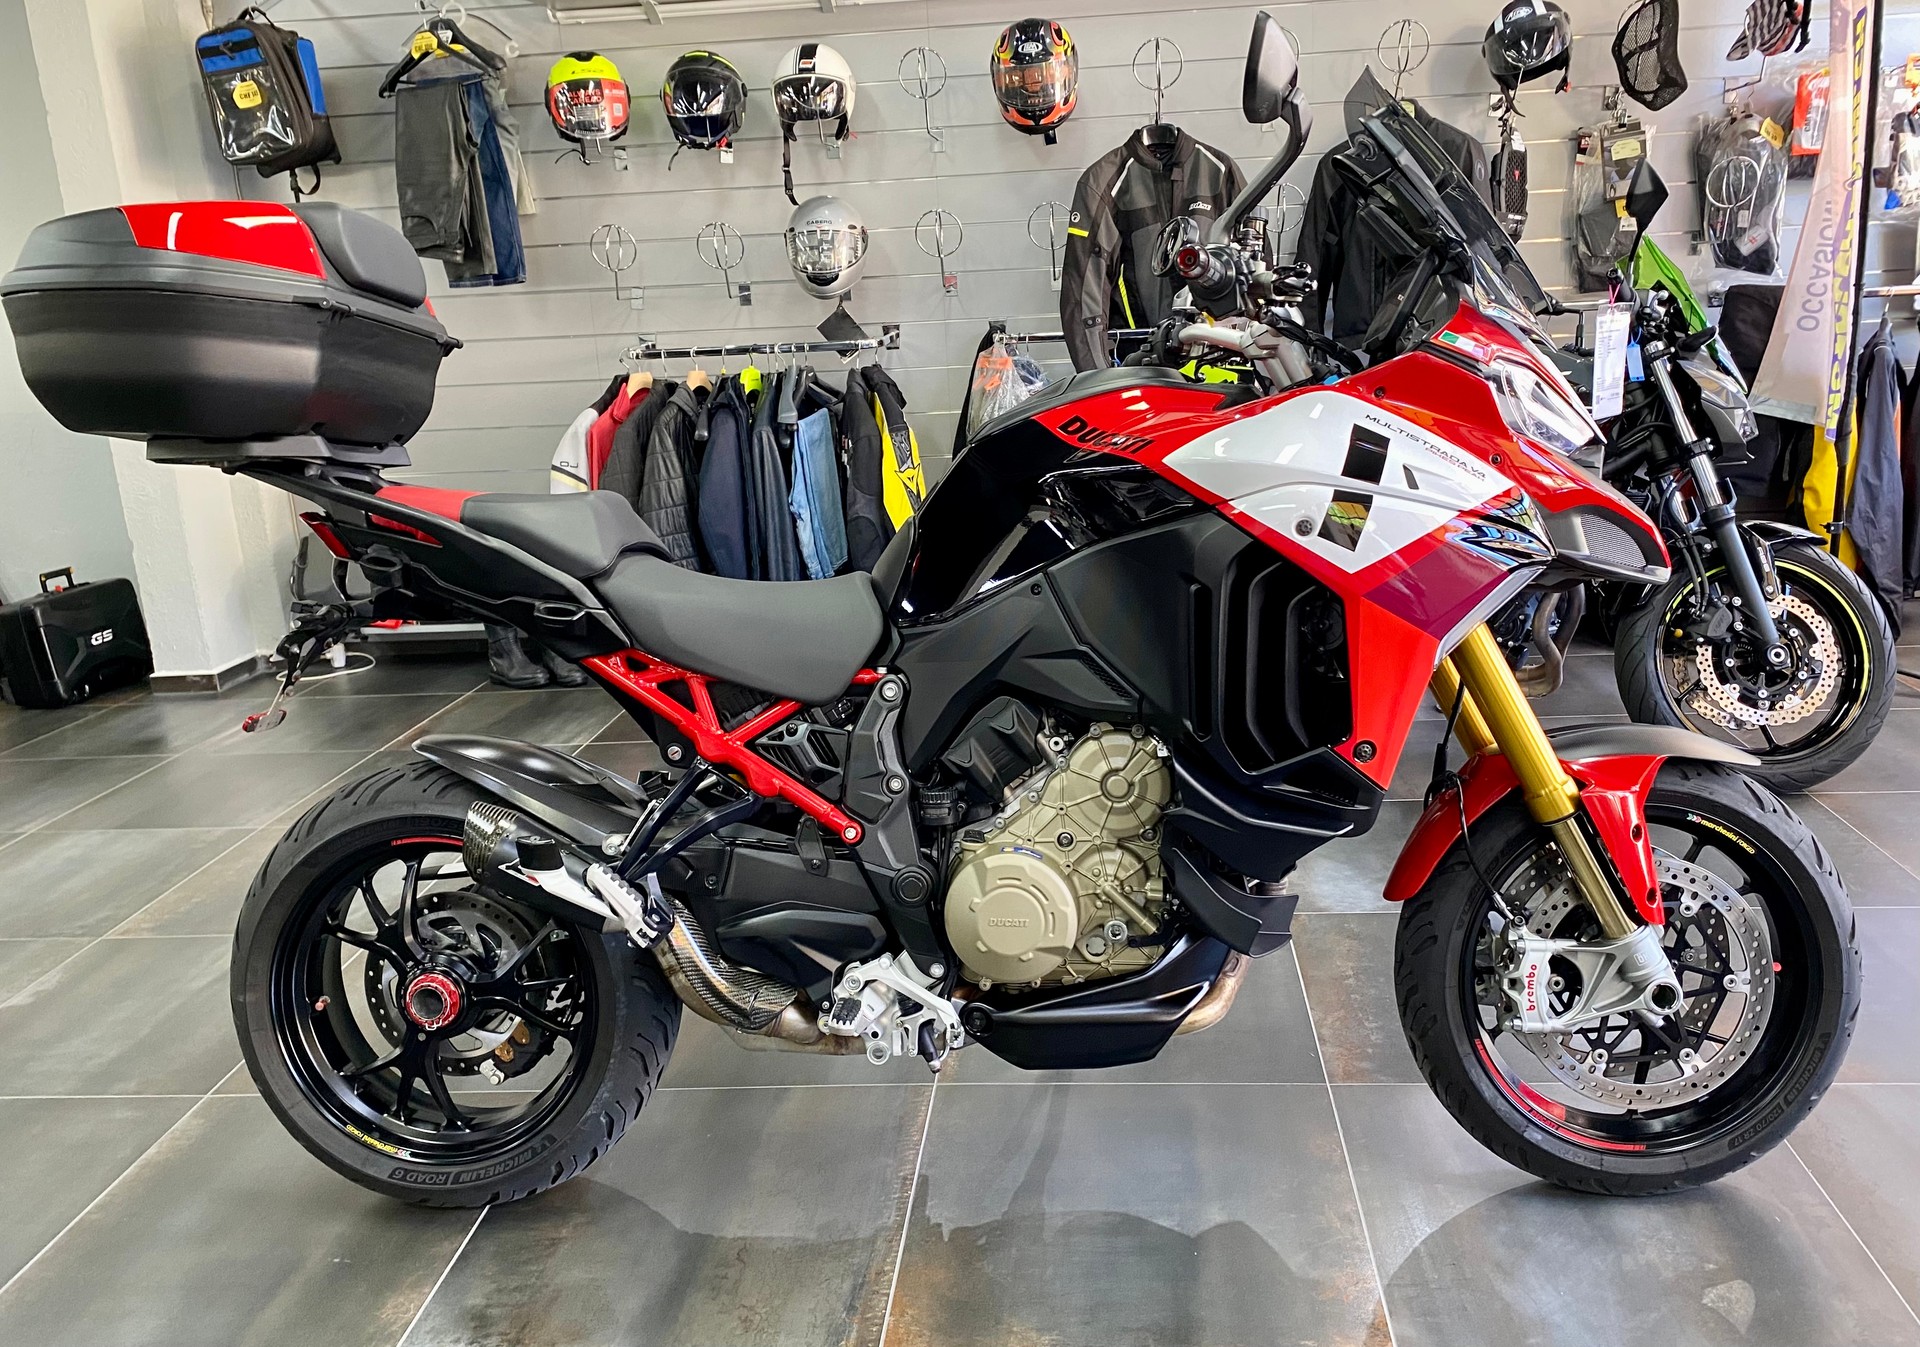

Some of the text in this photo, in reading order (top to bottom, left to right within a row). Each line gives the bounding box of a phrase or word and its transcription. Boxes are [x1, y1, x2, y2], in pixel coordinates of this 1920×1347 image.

[1056, 414, 1156, 455] DUCATI
[1364, 413, 1486, 479] MULTISTRADA V4
[90, 628, 114, 646] GS
[1700, 818, 1738, 843] marchesini
[988, 916, 1030, 929] DUCATI
[1525, 963, 1538, 1012] brembo
[1786, 1047, 1823, 1104] MICHELIN
[1734, 1105, 1783, 1146] 120/70 ZR 17
[392, 1168, 449, 1185] ROAD 6
[459, 1153, 533, 1184] MICHELIN
